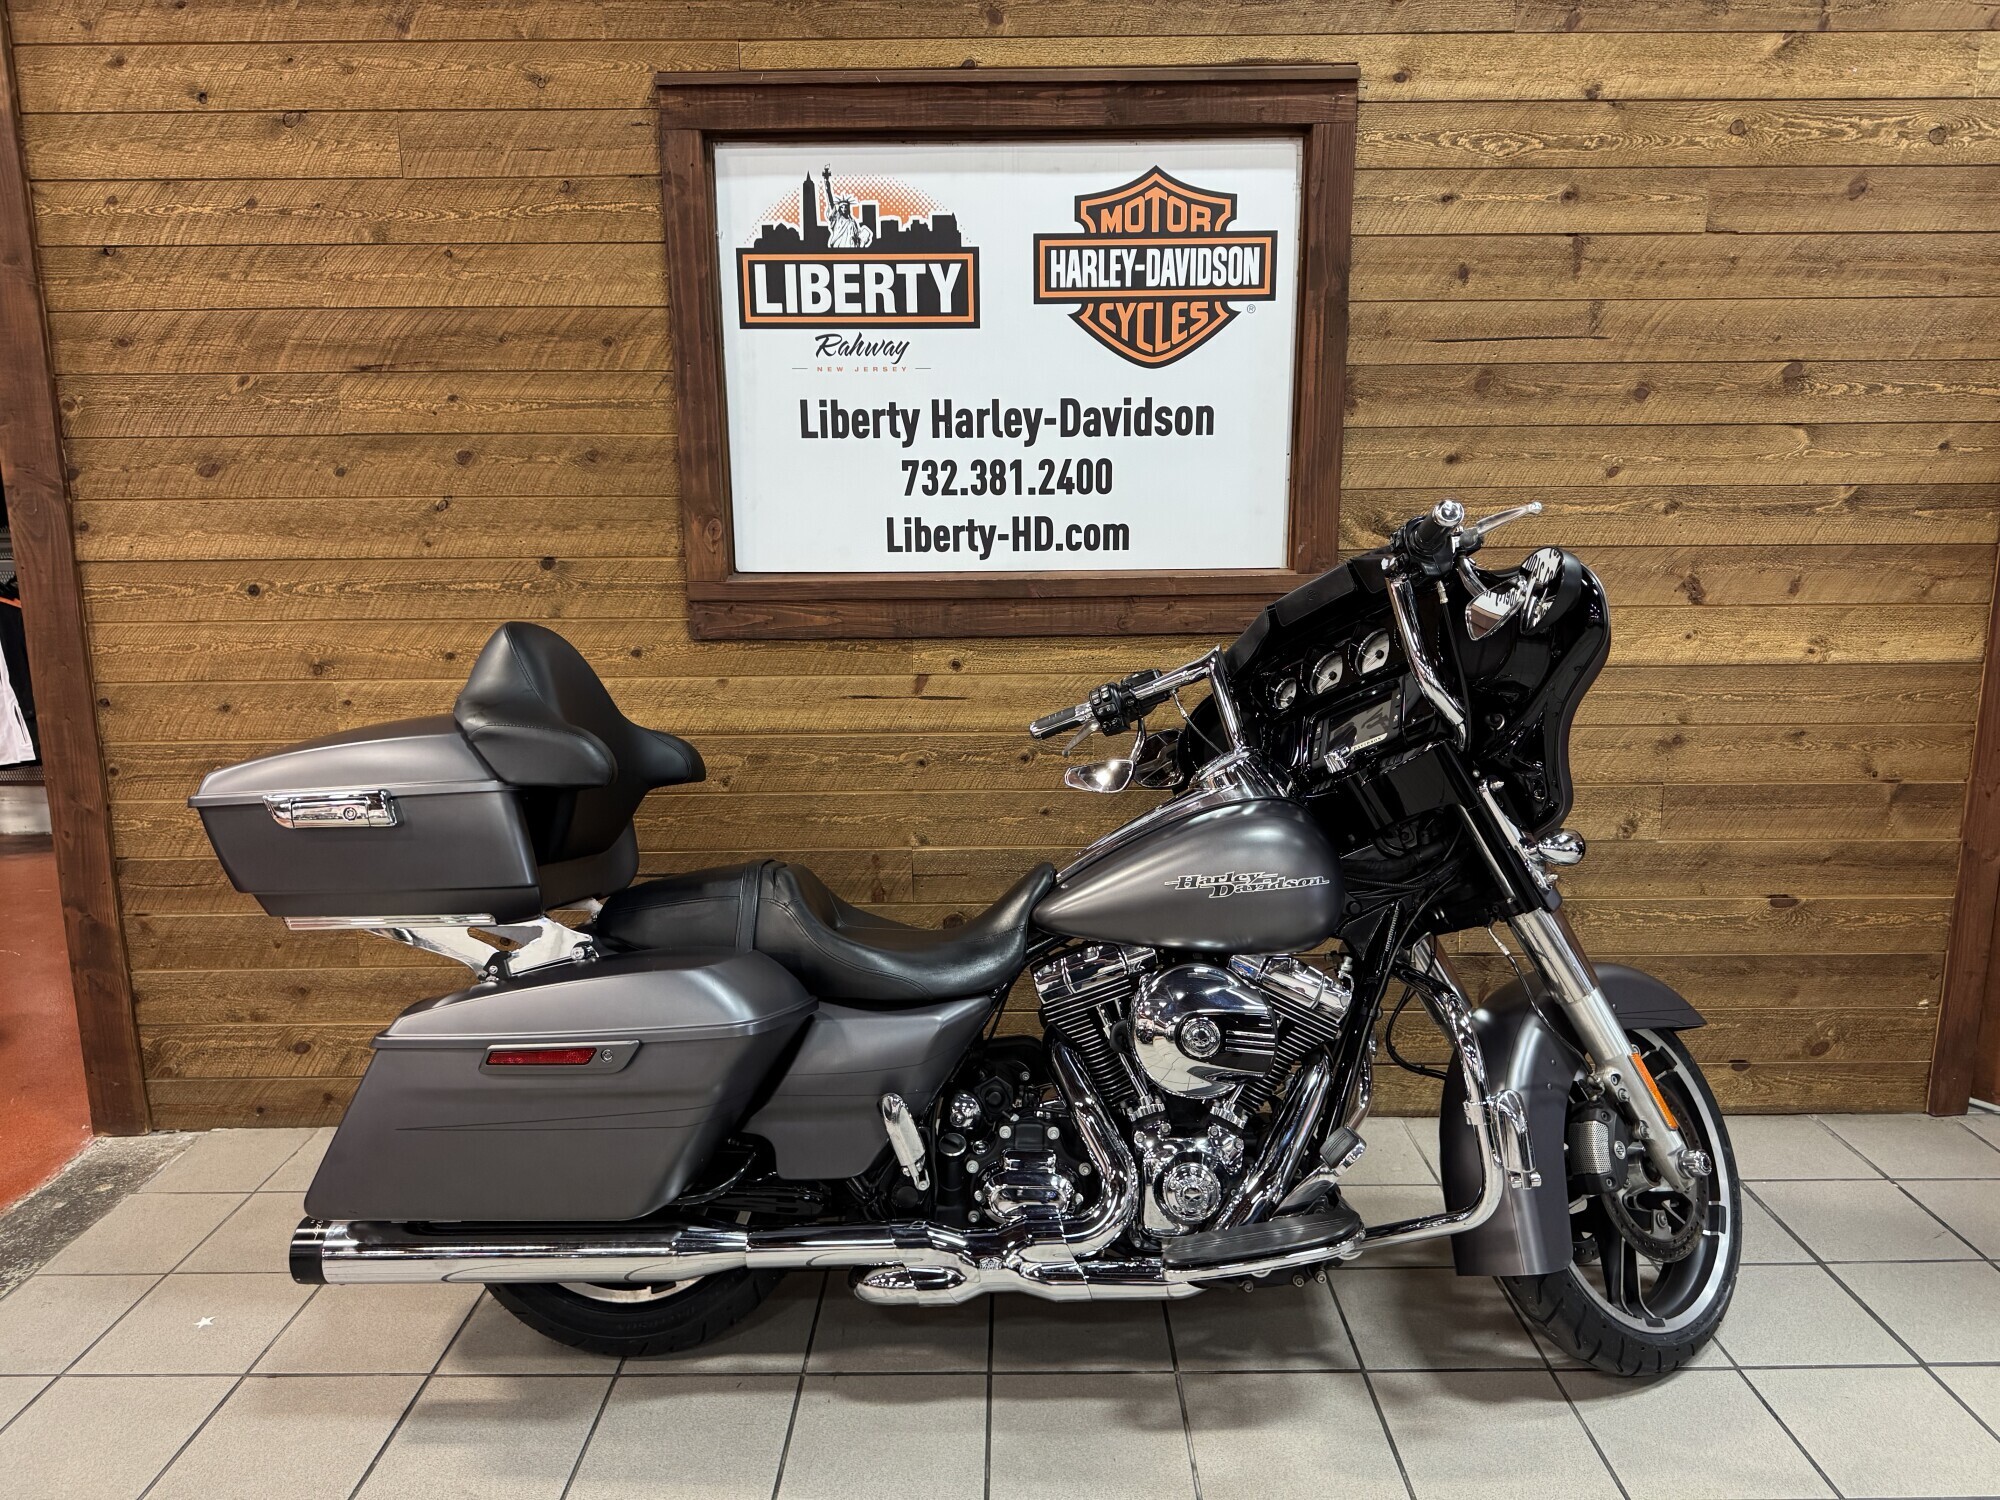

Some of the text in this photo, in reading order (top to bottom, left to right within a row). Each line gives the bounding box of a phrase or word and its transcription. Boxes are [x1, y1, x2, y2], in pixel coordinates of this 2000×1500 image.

[1100, 186, 1212, 233] MOTOR
[754, 263, 962, 314] LIBERTY
[1050, 245, 1260, 289] HARLEY-DAVIDSON
[814, 331, 911, 365] Rahway
[1099, 301, 1209, 353] CYCLES
[799, 397, 1215, 448] Liberty Harley-Davidson
[901, 458, 1113, 497] 732.381.2400
[886, 516, 1130, 561] Liberty-HD.com
